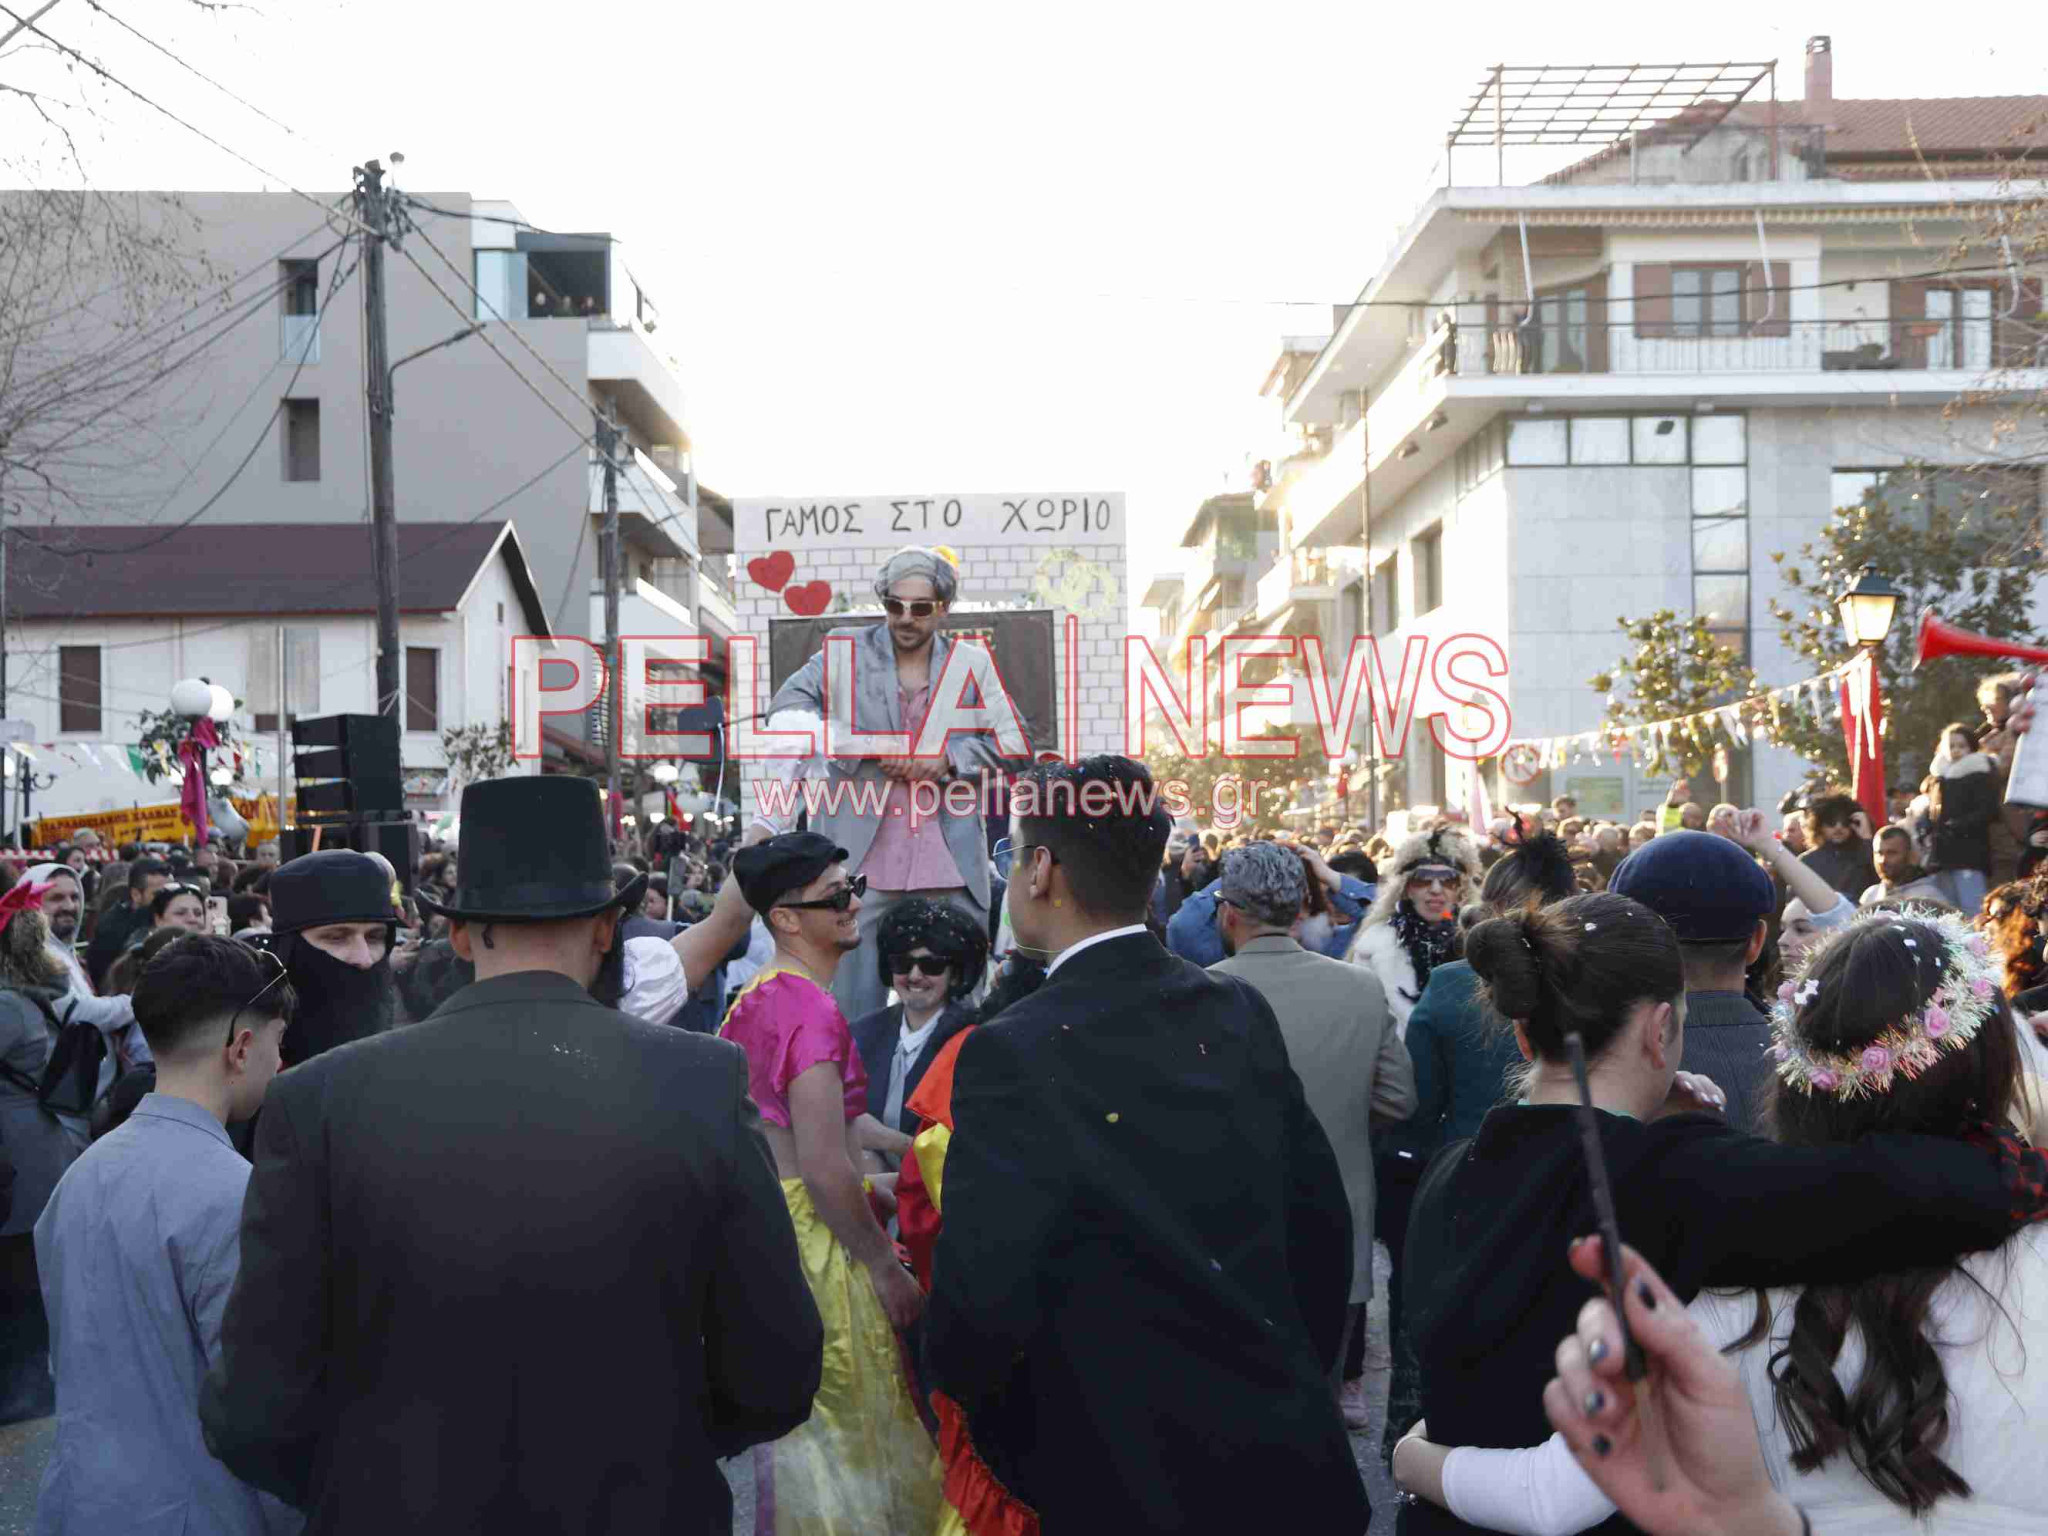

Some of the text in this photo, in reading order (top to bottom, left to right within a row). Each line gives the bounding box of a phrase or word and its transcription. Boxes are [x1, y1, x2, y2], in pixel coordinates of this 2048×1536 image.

[765, 498, 1111, 542] ΓΑΜΟΣ ΣΤΟ ΧΩΡΙΟ
